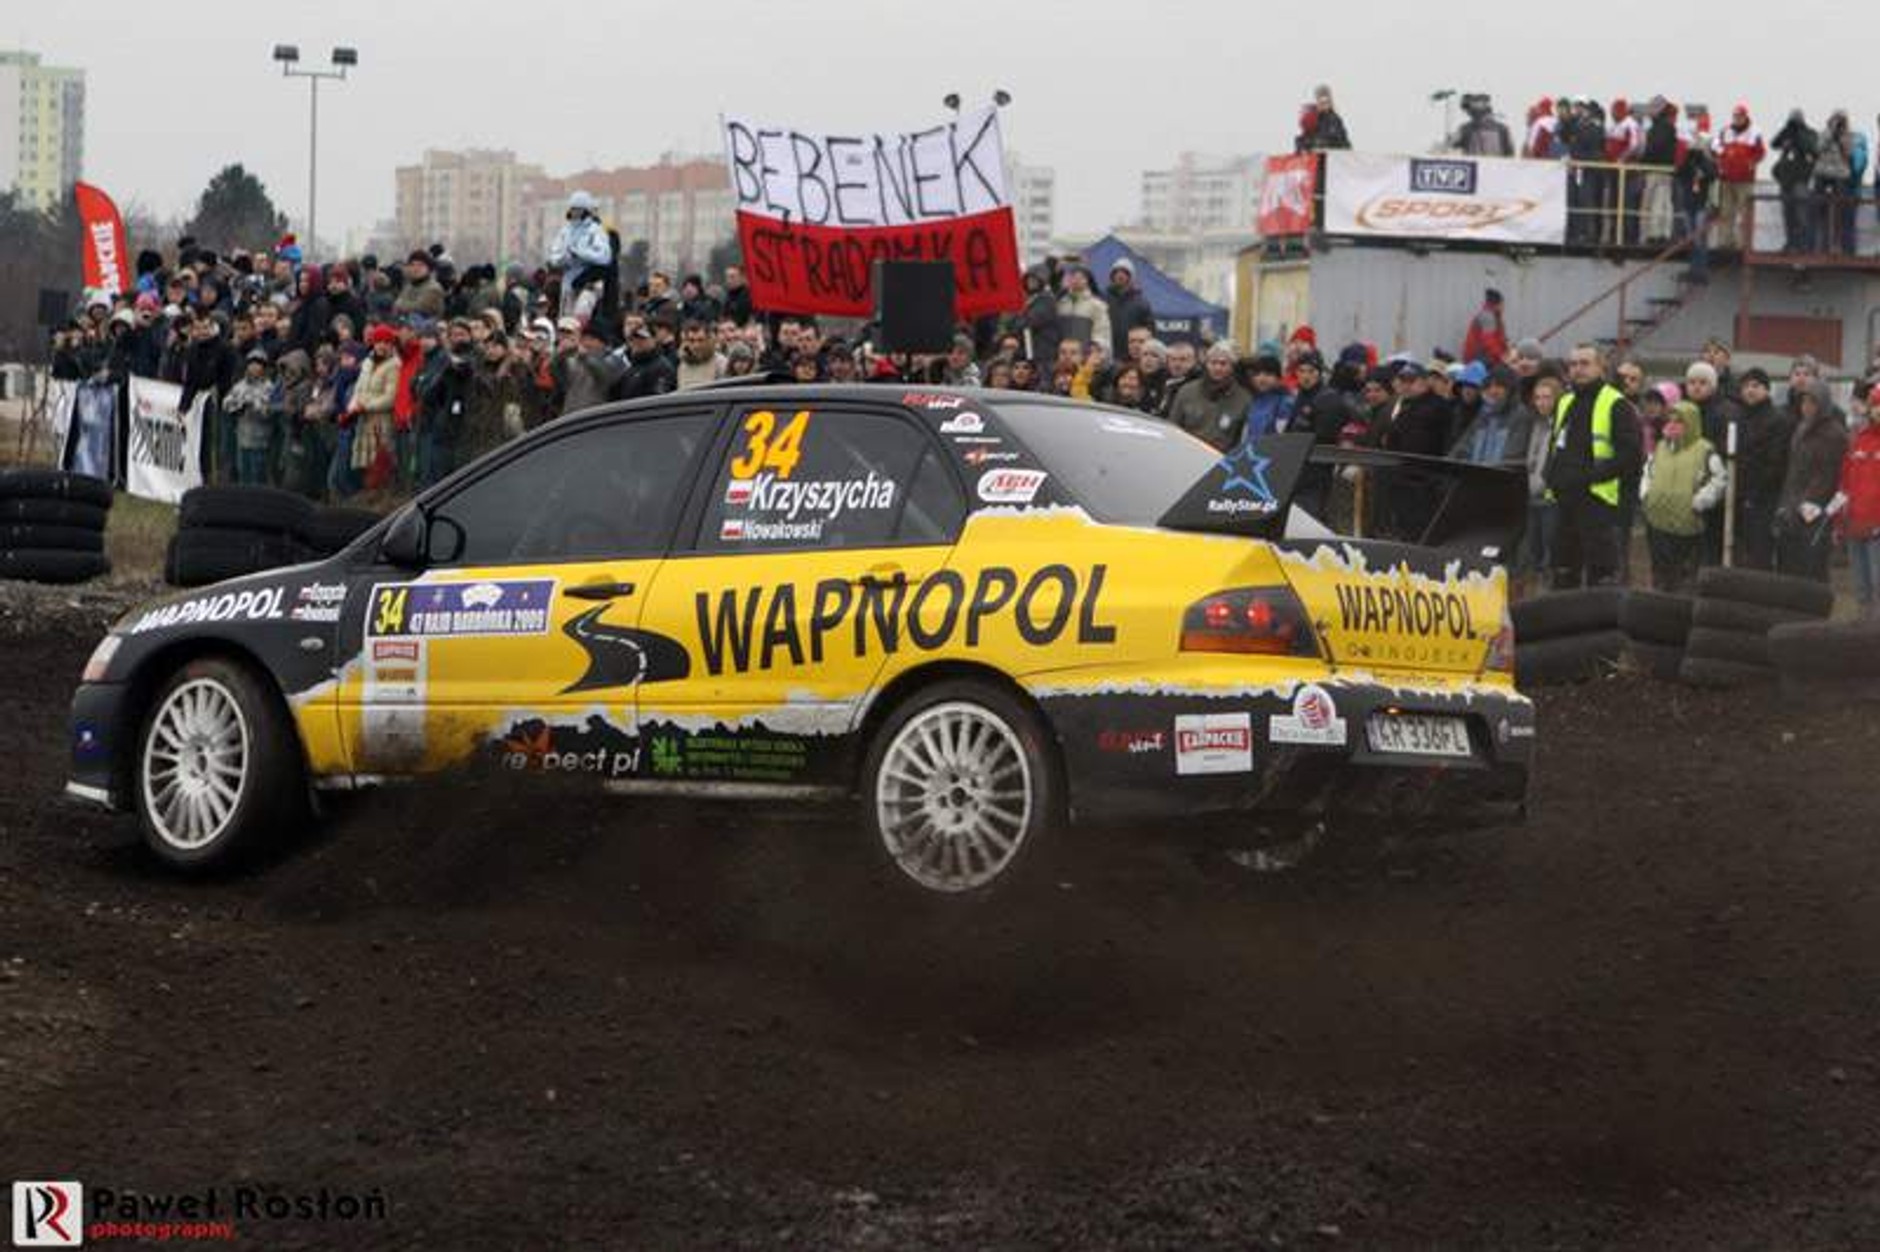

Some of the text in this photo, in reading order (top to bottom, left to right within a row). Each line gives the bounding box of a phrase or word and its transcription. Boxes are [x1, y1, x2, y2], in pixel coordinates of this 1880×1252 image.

[1419, 166, 1467, 188] TVP
[1376, 198, 1504, 221] SPORT
[731, 410, 810, 479] 34
[748, 470, 895, 519] Krzyszycha
[743, 519, 823, 540] Nowakowski
[131, 586, 285, 635] WAPNOPOL
[374, 588, 408, 635] 34
[695, 563, 1117, 677] WAPNOPOL
[1335, 583, 1476, 640] WAPNOPOL
